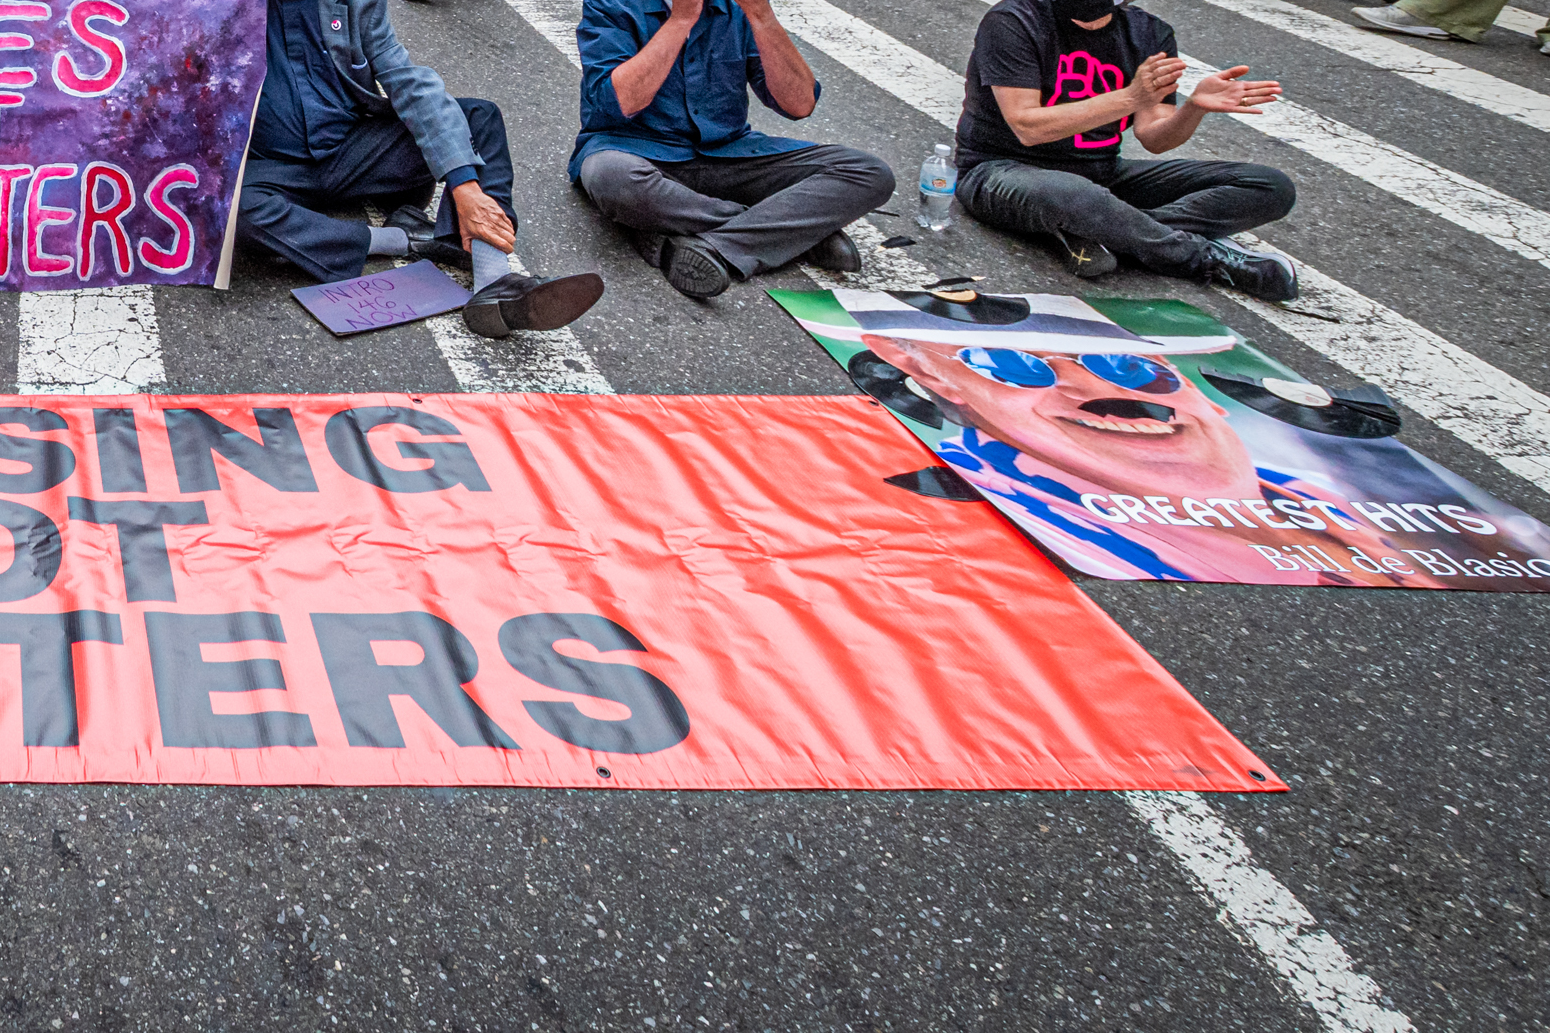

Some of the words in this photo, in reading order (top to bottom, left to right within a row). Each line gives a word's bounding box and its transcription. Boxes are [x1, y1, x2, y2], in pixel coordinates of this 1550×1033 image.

[318, 277, 395, 304] INTRO
[344, 304, 418, 330] NOW
[1079, 492, 1357, 532] GREATEST
[1354, 501, 1498, 536] HITS
[1247, 542, 1352, 574] Bill
[1346, 545, 1417, 577] de
